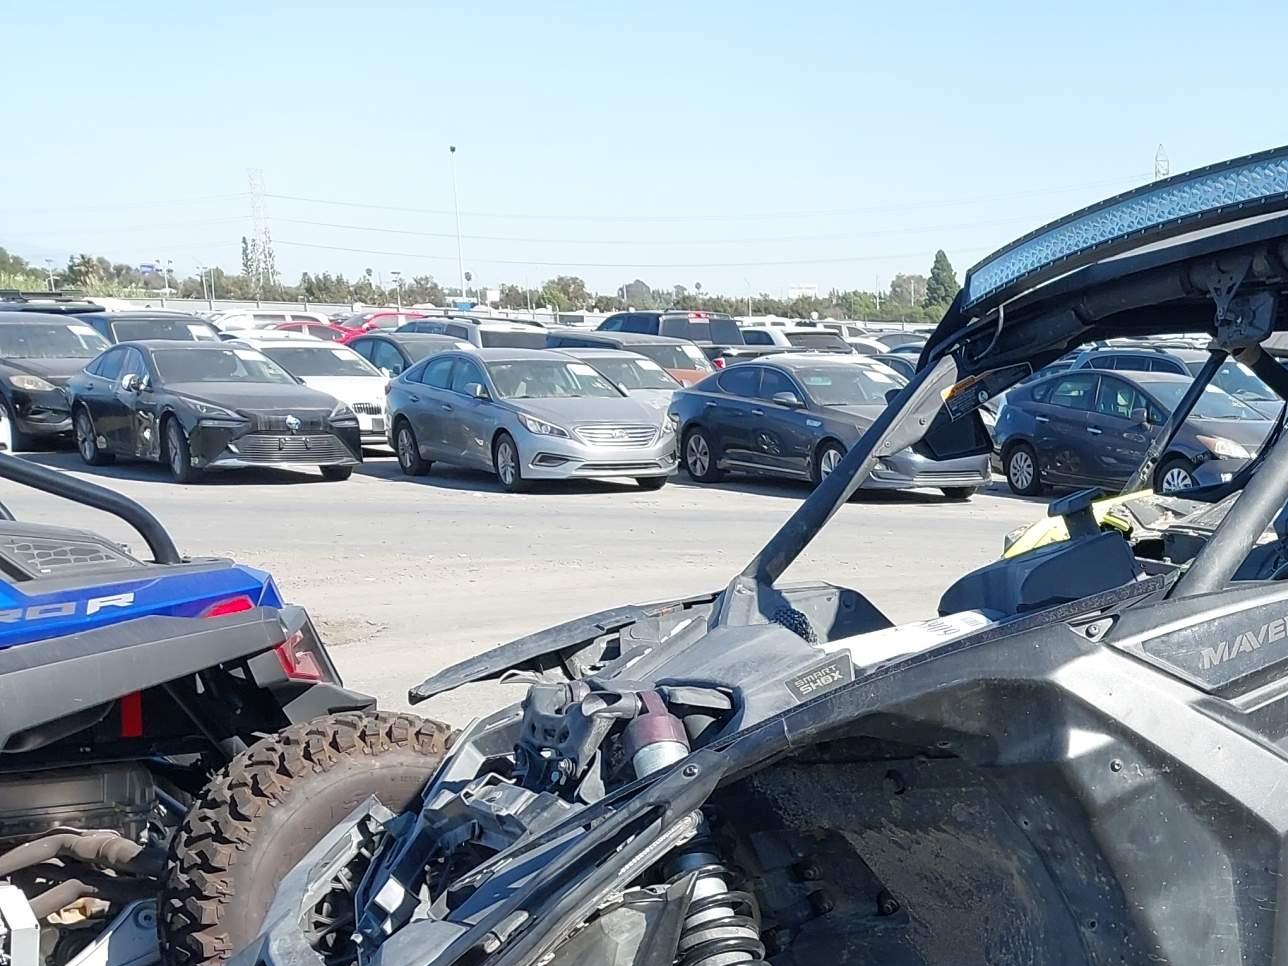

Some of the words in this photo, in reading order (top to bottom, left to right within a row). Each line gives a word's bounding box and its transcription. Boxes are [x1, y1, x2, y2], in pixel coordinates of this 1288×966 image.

[86, 592, 135, 616] R
[794, 664, 838, 688] SMART
[799, 670, 844, 695] SHOX
